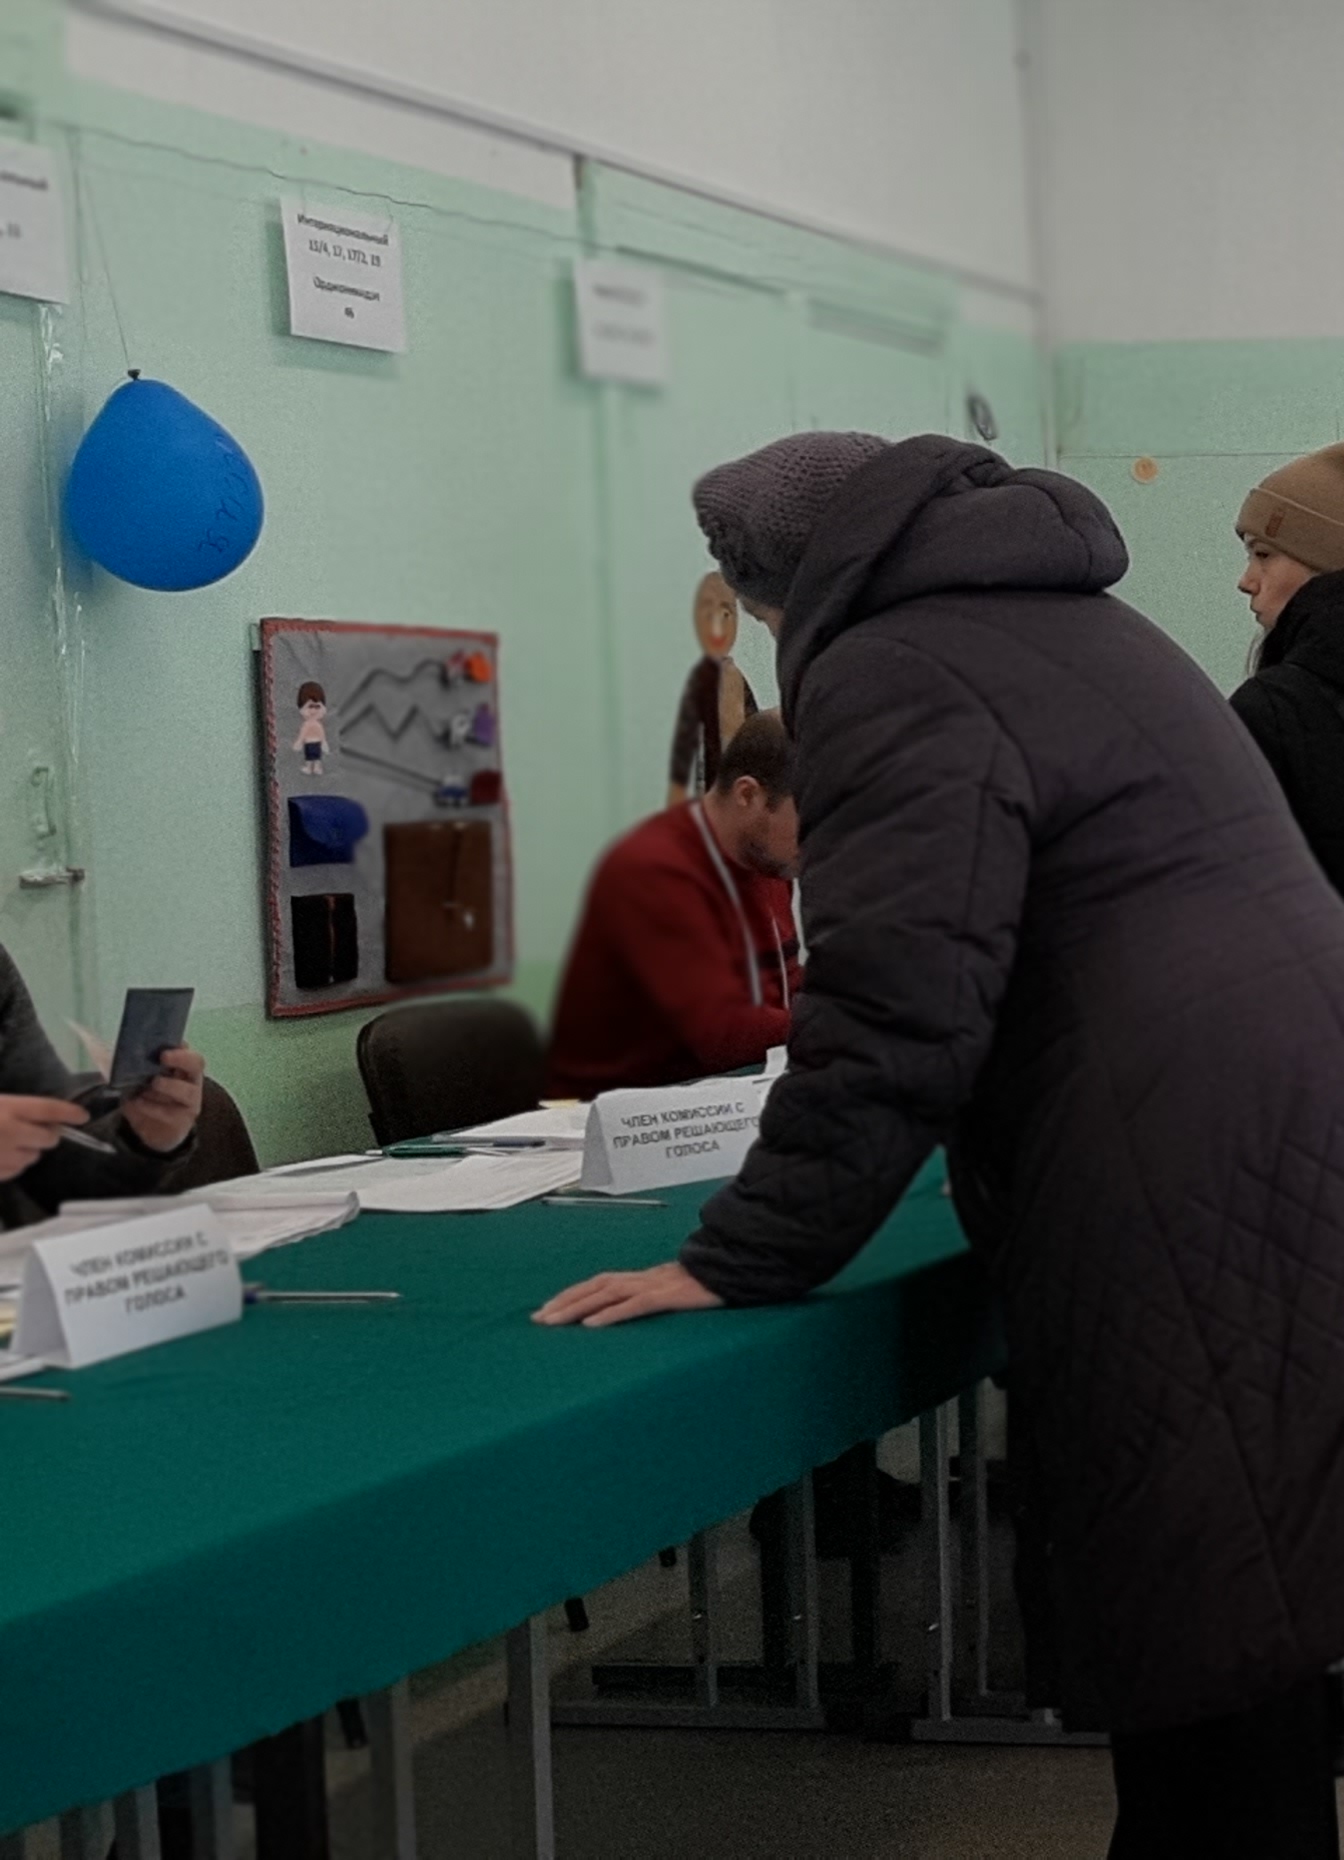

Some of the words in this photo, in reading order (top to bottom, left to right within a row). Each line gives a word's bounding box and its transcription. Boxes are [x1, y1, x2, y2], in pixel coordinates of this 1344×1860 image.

[620, 1113, 658, 1129] ЧЛЕН
[661, 1104, 733, 1124] КОМИССИИ
[735, 1102, 745, 1113] С
[612, 1129, 671, 1149] ПРАВОМ
[674, 1115, 760, 1140] РЕШАЮЩЕГО
[665, 1139, 720, 1159] ГОЛОСА
[70, 1254, 113, 1277] ЧЛЕН
[115, 1234, 193, 1267] КОМИССИИ
[64, 1274, 130, 1306] ПРАВОМ
[125, 1283, 186, 1314] ГОЛОСА
